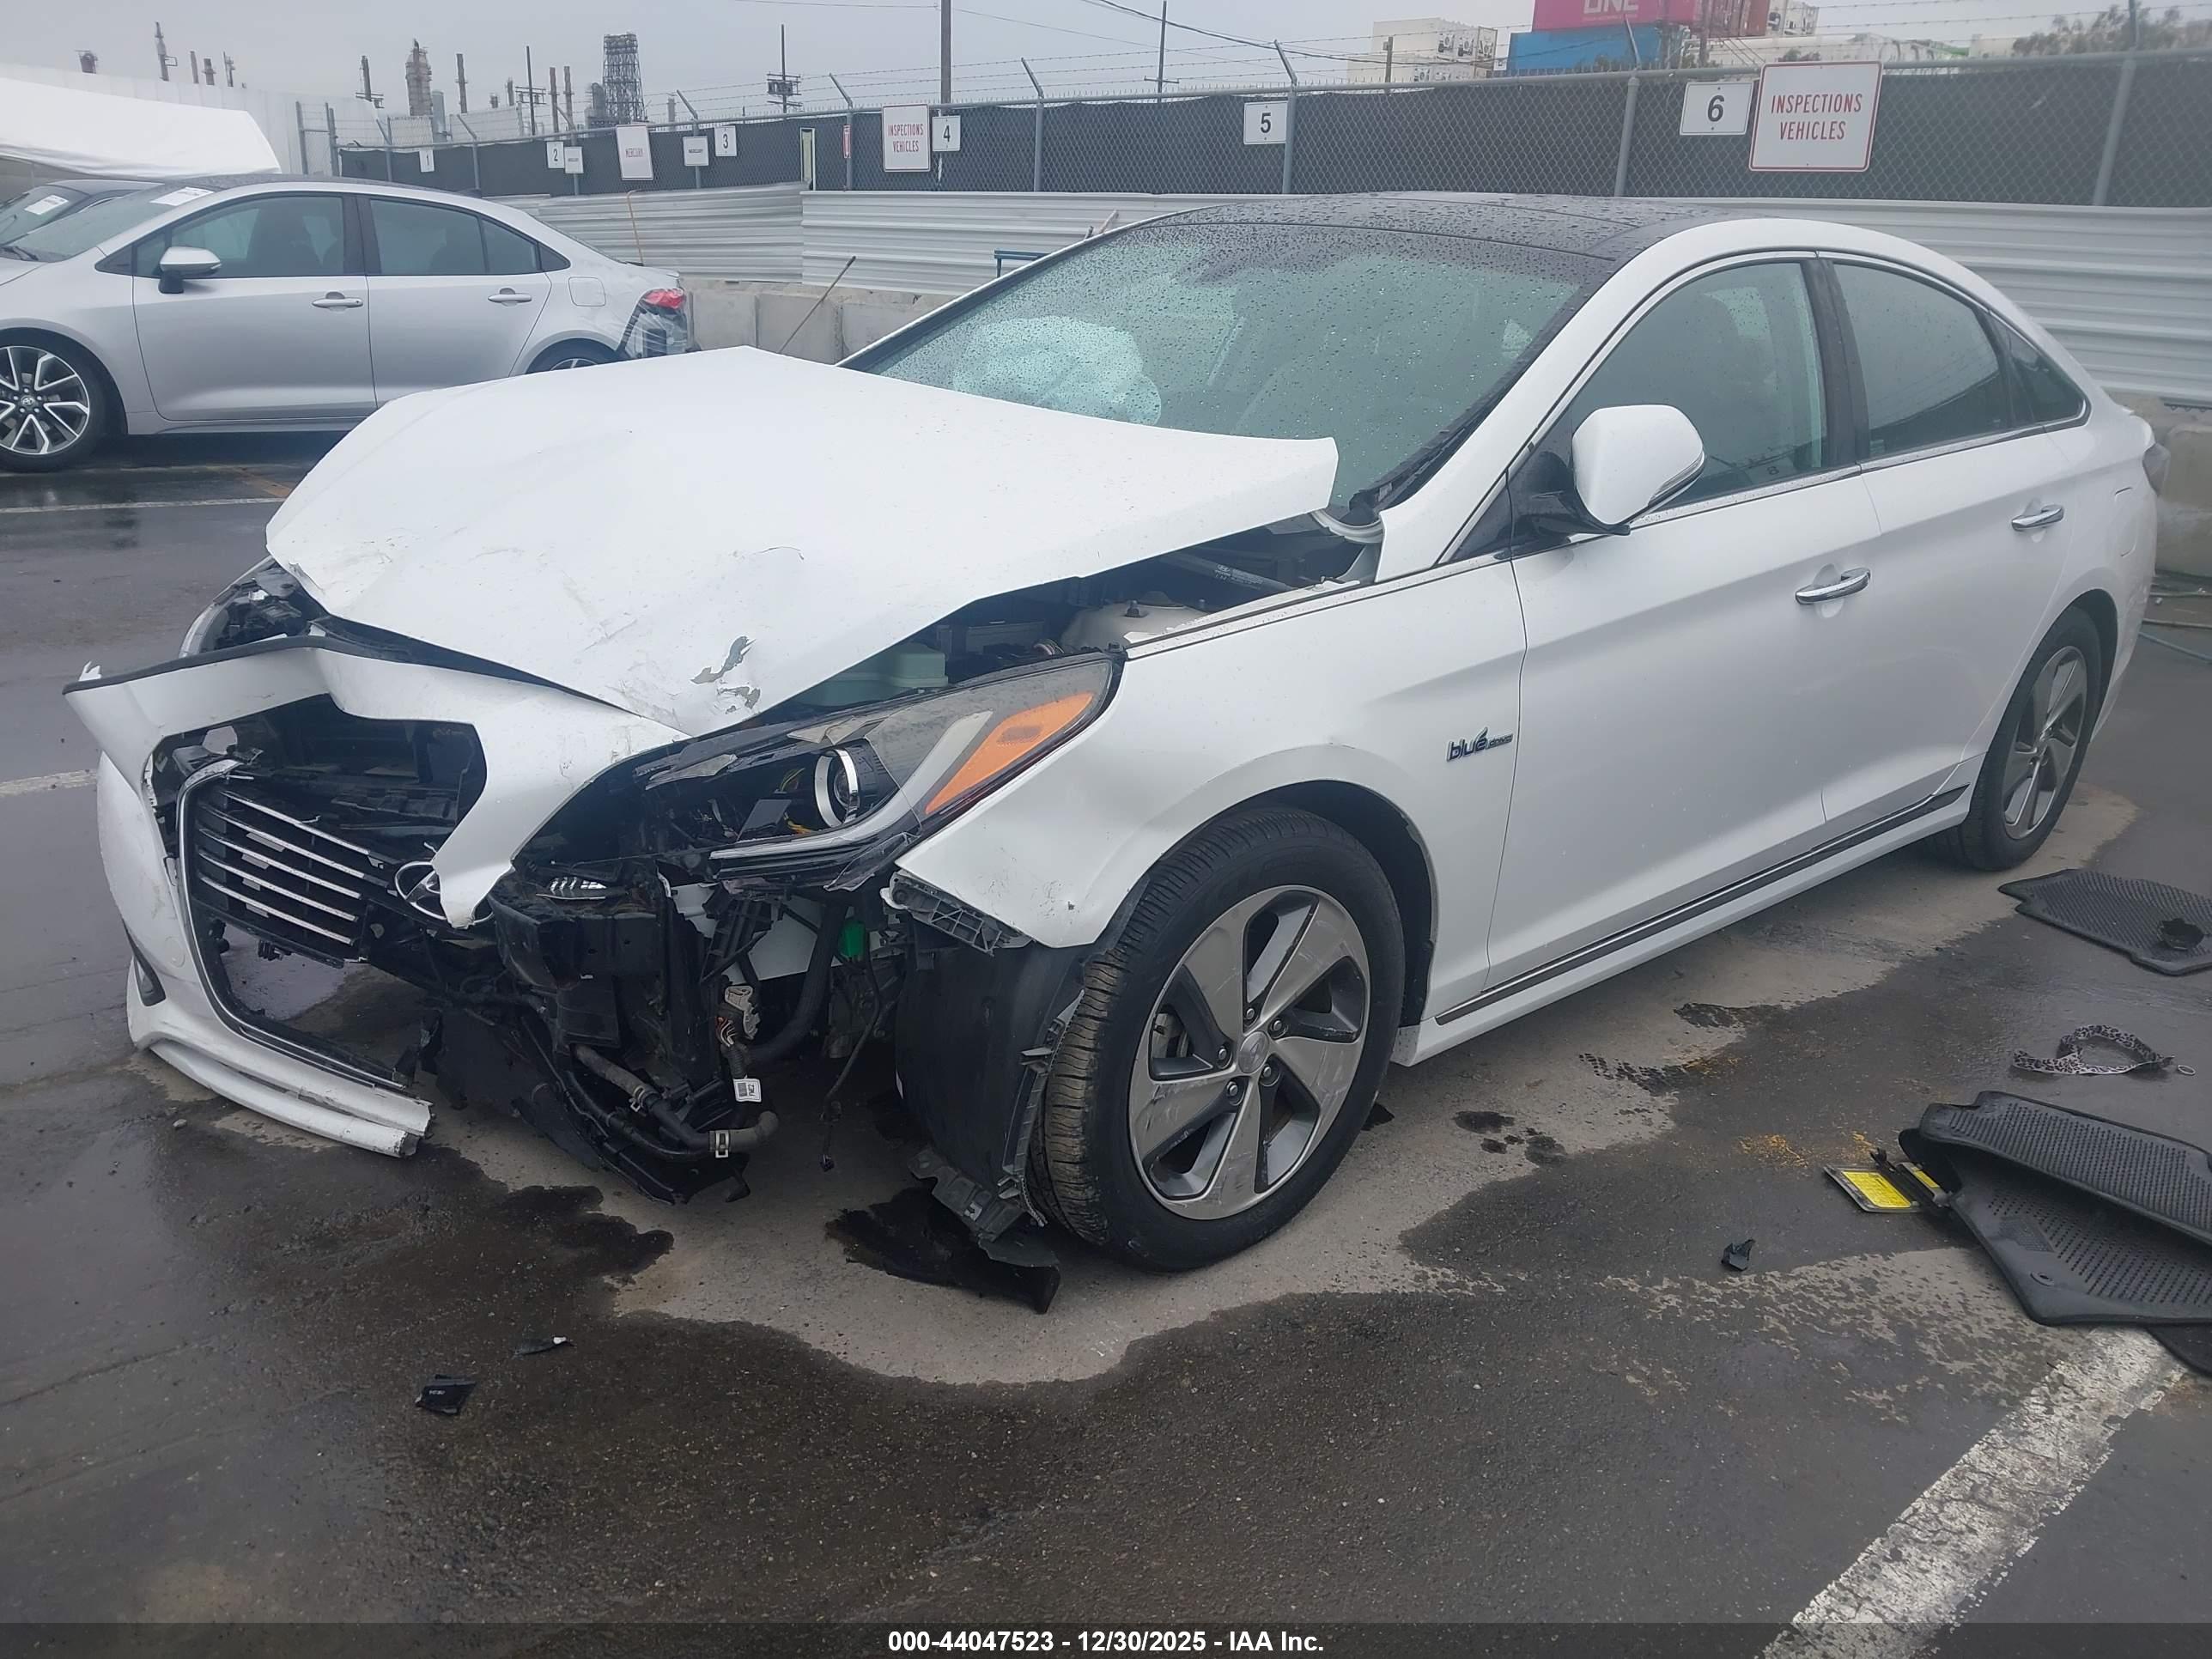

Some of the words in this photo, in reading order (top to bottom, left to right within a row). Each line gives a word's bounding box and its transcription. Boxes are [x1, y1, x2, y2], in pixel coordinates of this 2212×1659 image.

[1707, 94, 1725, 122] 6
[1771, 93, 1863, 114] INSPECTIONS
[888, 124, 923, 137] INSPECTIONS
[1260, 112, 1271, 133] 5
[1779, 120, 1846, 140] VEHICLES
[722, 133, 728, 149] 3
[943, 125, 951, 143] 4
[553, 148, 559, 162] 2
[892, 141, 919, 152] VEHICLES
